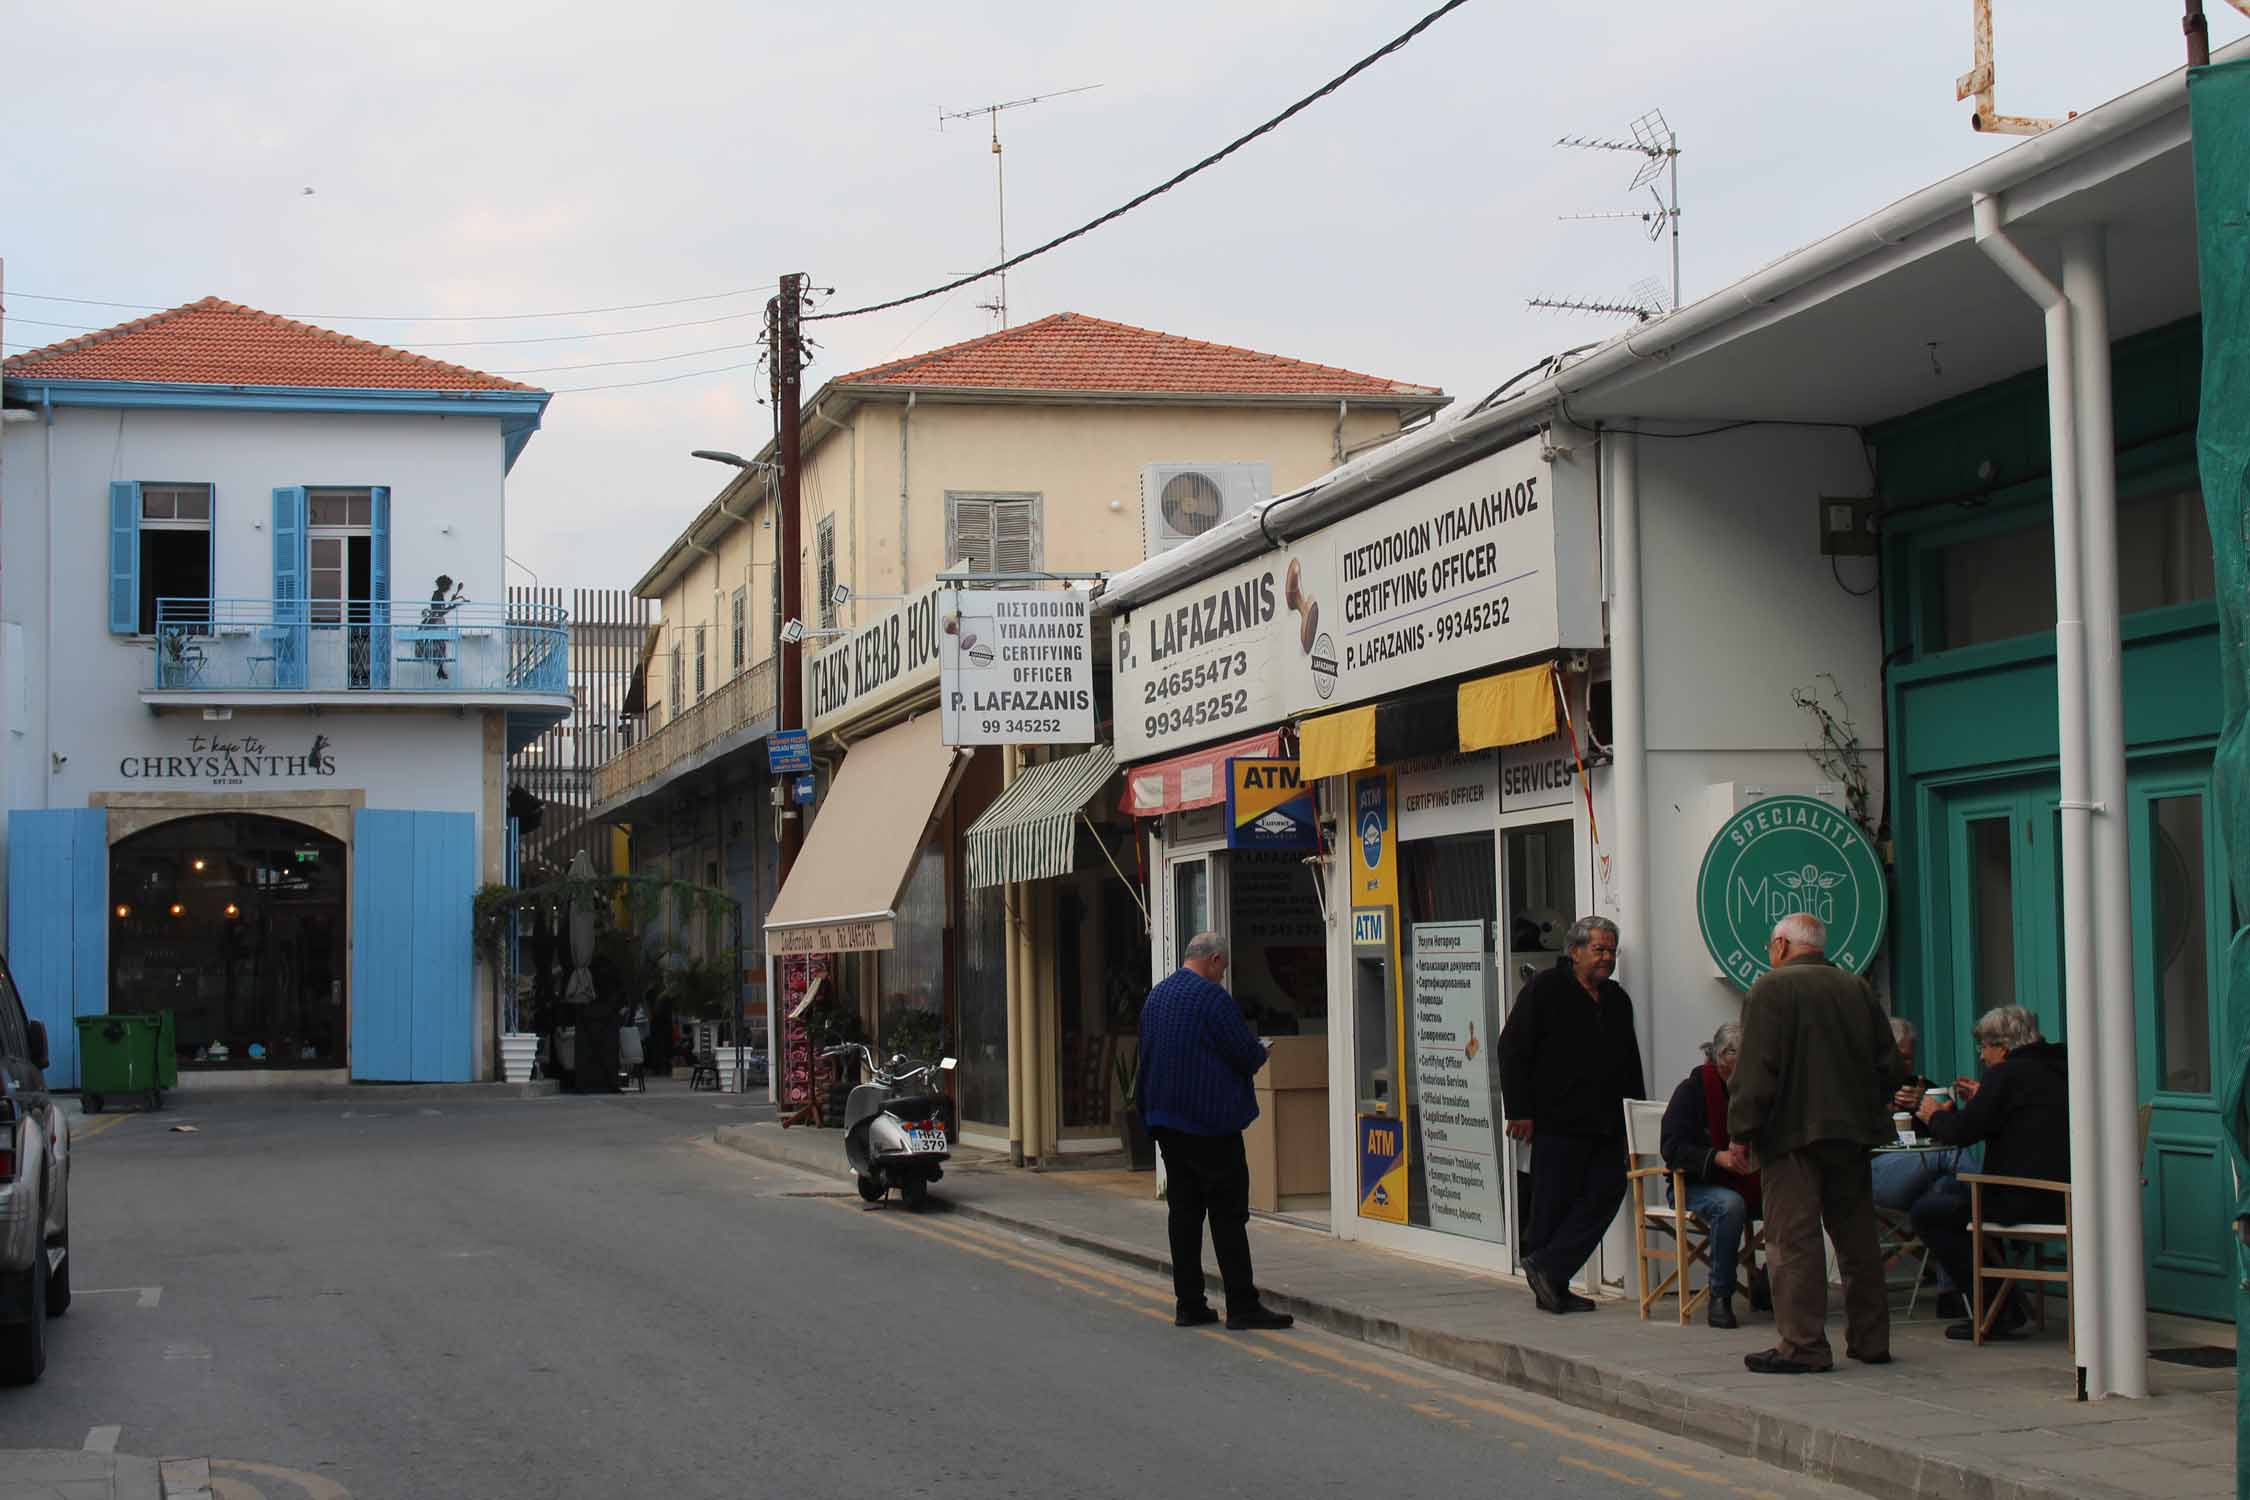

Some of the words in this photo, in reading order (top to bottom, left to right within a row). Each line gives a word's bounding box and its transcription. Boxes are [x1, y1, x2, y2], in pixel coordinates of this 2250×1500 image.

[1343, 520, 1430, 583] ΠΙΣΤΟΠΟΙΩΝ
[1434, 477, 1538, 547] ΥΠΑΛΛΗΛΟΣ
[1345, 567, 1427, 624] CERTIFYING
[1432, 541, 1497, 593] OFFICER
[997, 601, 1085, 618] ΠΙΣΤΟΠΟΙΩΝ
[1118, 630, 1136, 673] P.
[1150, 571, 1276, 662] LAFAZANIS
[1000, 623, 1084, 639] ΥΠΑΛΛΗΛΟΣ
[1346, 646, 1356, 671] P.
[1359, 623, 1425, 667] LAFAZANIS
[1436, 596, 1510, 644] 99345252
[812, 644, 849, 719] TAKIS
[854, 613, 900, 699] KEBAB
[1002, 645, 1082, 662] CERTIFYING
[1013, 667, 1072, 683] OFFICER
[1144, 650, 1247, 704] 24655473
[951, 691, 967, 712] P.
[974, 690, 1089, 712] LAFAZANIS
[1145, 689, 1248, 738] 99345252
[982, 719, 1000, 733] 99
[1005, 719, 1061, 733] 345252
[1243, 766, 1305, 789] ATM
[1504, 758, 1572, 796] SERVICES
[1360, 788, 1381, 809] ATM
[1406, 790, 1450, 812] CERTIFYING
[1450, 784, 1484, 805] OFFICER
[1731, 807, 1856, 850] SPECIALITY
[1355, 914, 1382, 940] ATM
[1728, 950, 1766, 984] COF
[921, 1139, 945, 1151] 379
[1367, 1128, 1394, 1157] ATM
